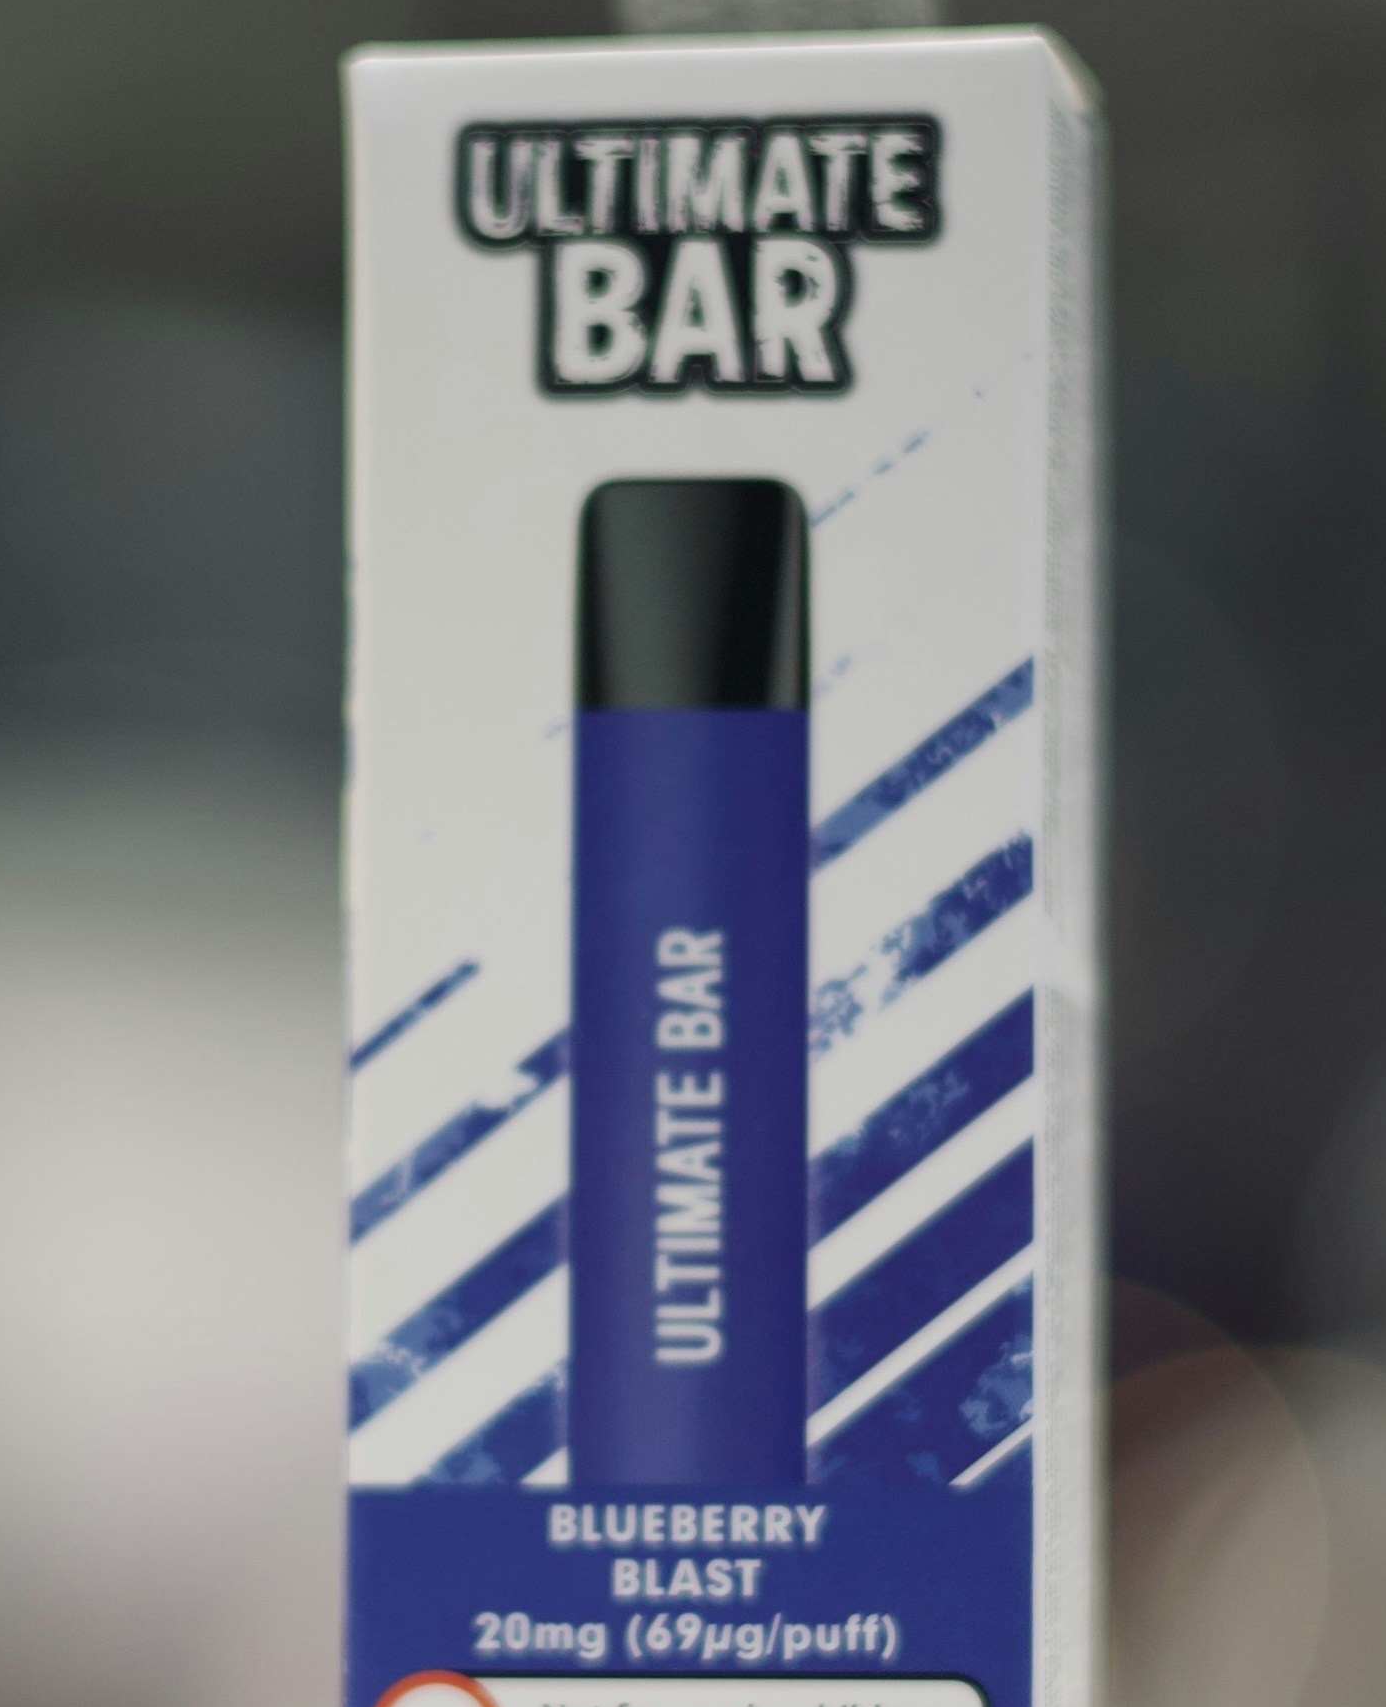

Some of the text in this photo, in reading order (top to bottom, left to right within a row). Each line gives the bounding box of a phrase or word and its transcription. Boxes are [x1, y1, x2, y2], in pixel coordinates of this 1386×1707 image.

[466, 131, 927, 241] ULTIMATE
[551, 237, 839, 385] BAR
[654, 927, 724, 1367] ULTIMATE BAR
[547, 1503, 828, 1546] BLUEBERRY
[611, 1558, 763, 1601] BLAST
[473, 1611, 608, 1663] 20mg
